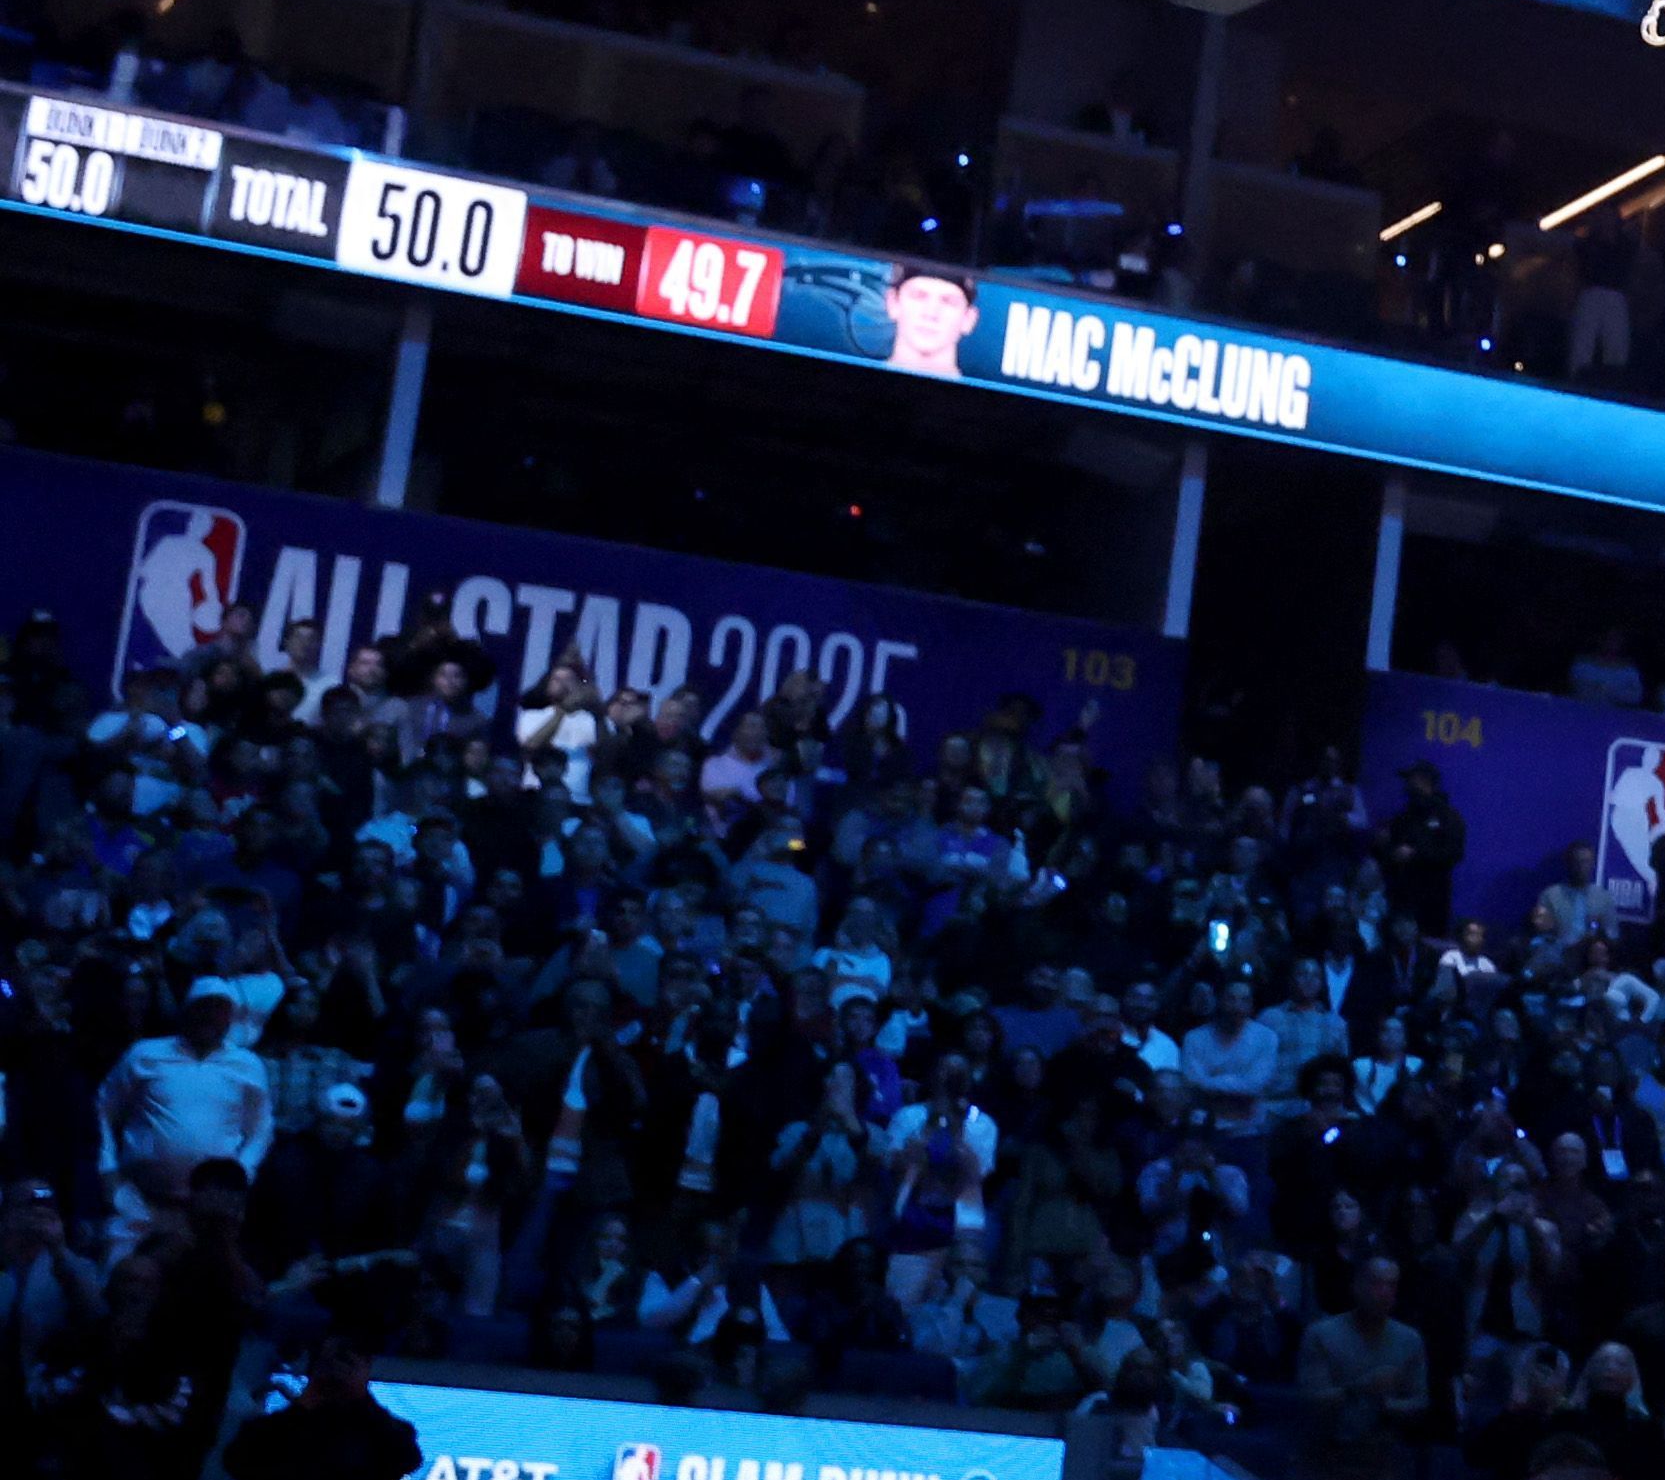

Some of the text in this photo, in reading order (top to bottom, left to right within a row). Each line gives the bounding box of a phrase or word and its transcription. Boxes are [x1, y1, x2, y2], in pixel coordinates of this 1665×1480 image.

[20, 139, 117, 217] 50.0
[230, 163, 329, 237] TOTAL
[370, 181, 494, 278] 50.0
[657, 236, 768, 330] 49.7
[1001, 301, 1105, 393] MAC
[1107, 320, 1313, 430] McCLUNG
[1061, 648, 1138, 694] 103
[1421, 710, 1483, 749] 104
